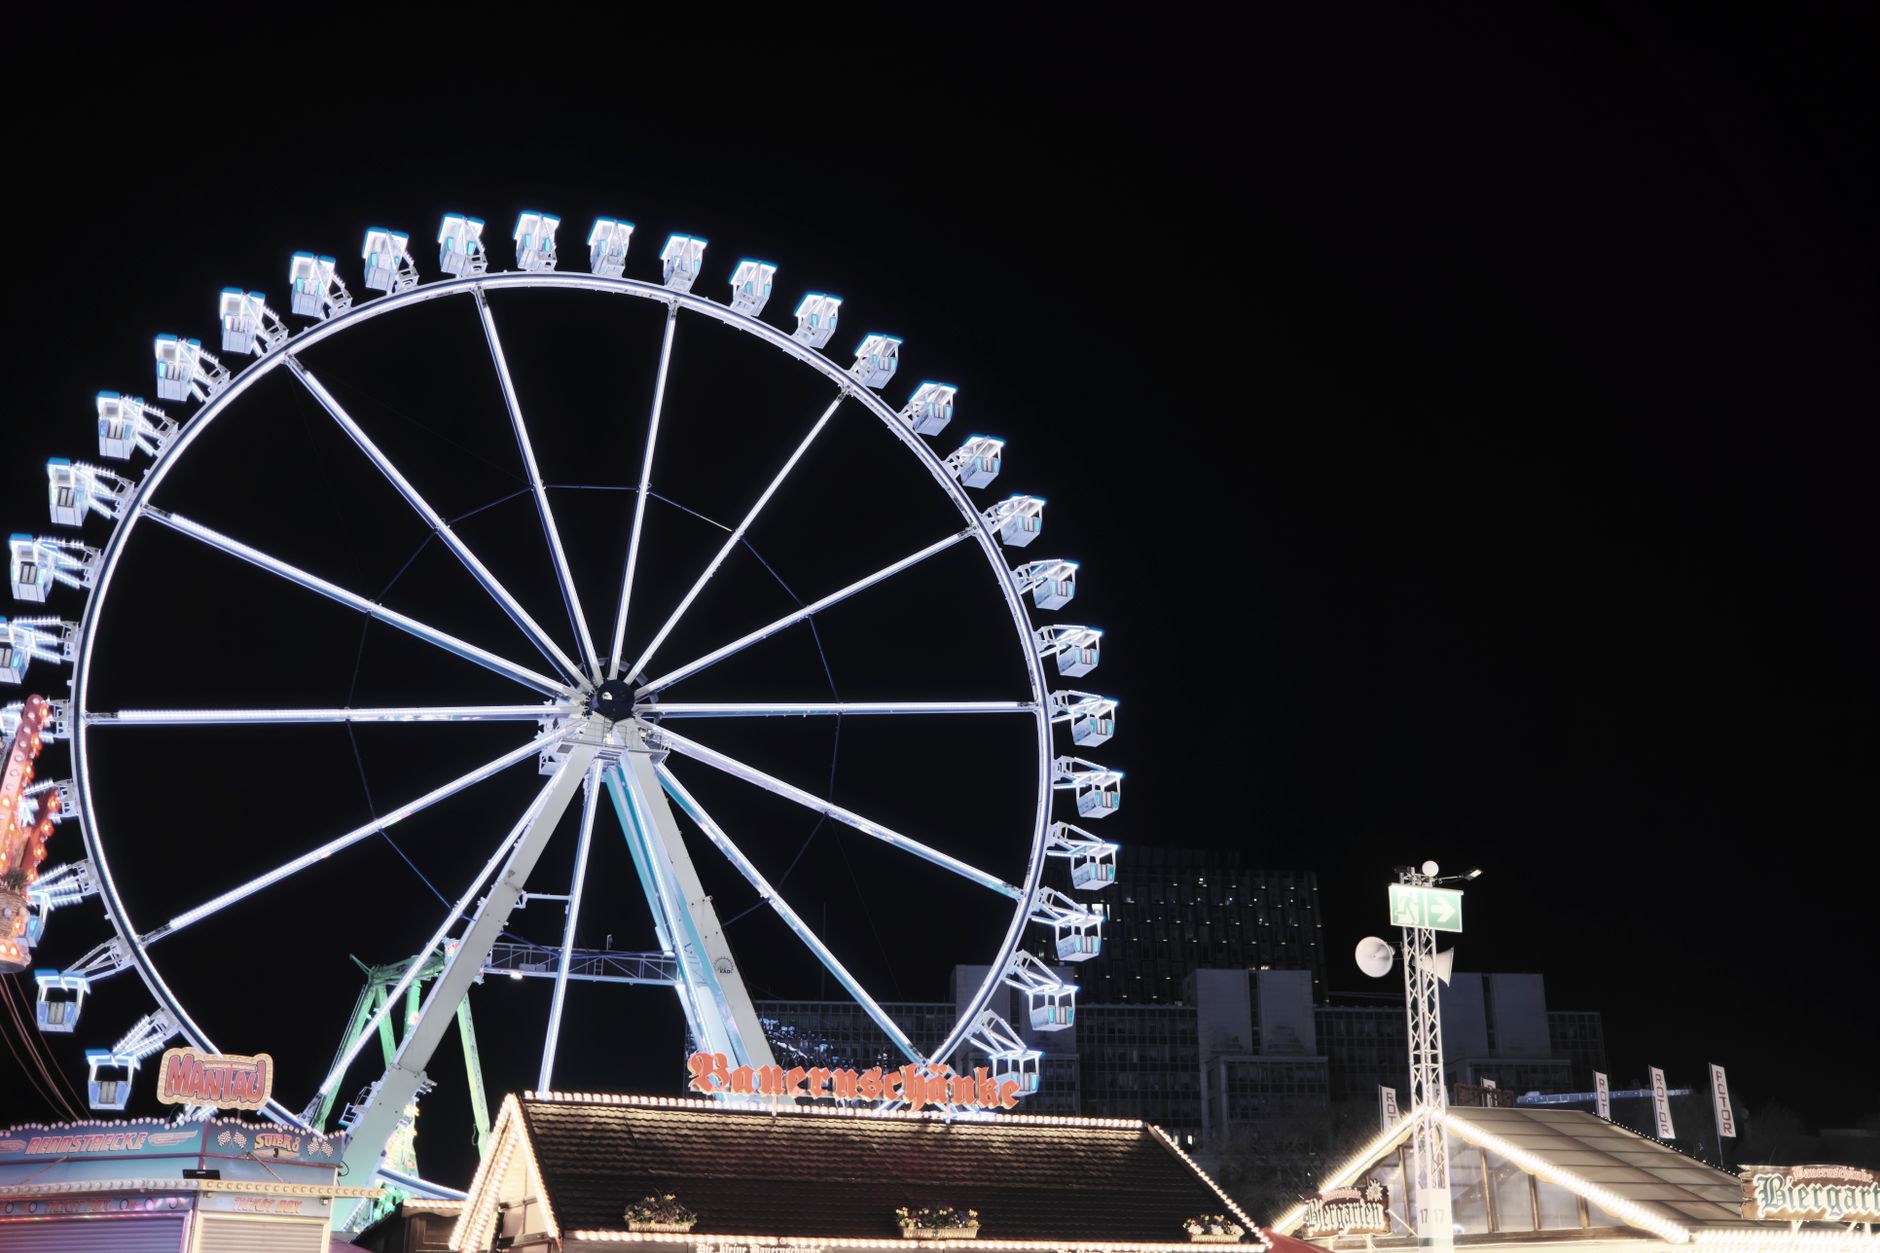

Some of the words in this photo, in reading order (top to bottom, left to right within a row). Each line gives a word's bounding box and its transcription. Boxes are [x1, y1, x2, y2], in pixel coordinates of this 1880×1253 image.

[688, 1052, 1020, 1112] Bauernschänke
[1598, 1078, 1609, 1116] ROT
[1386, 1092, 1397, 1124] ROT
[1655, 1074, 1671, 1136] ROTOR
[1715, 1070, 1732, 1134] ROTOR
[25, 1132, 148, 1155] RENNSTRECKE
[1307, 1198, 1384, 1235] Biergarten
